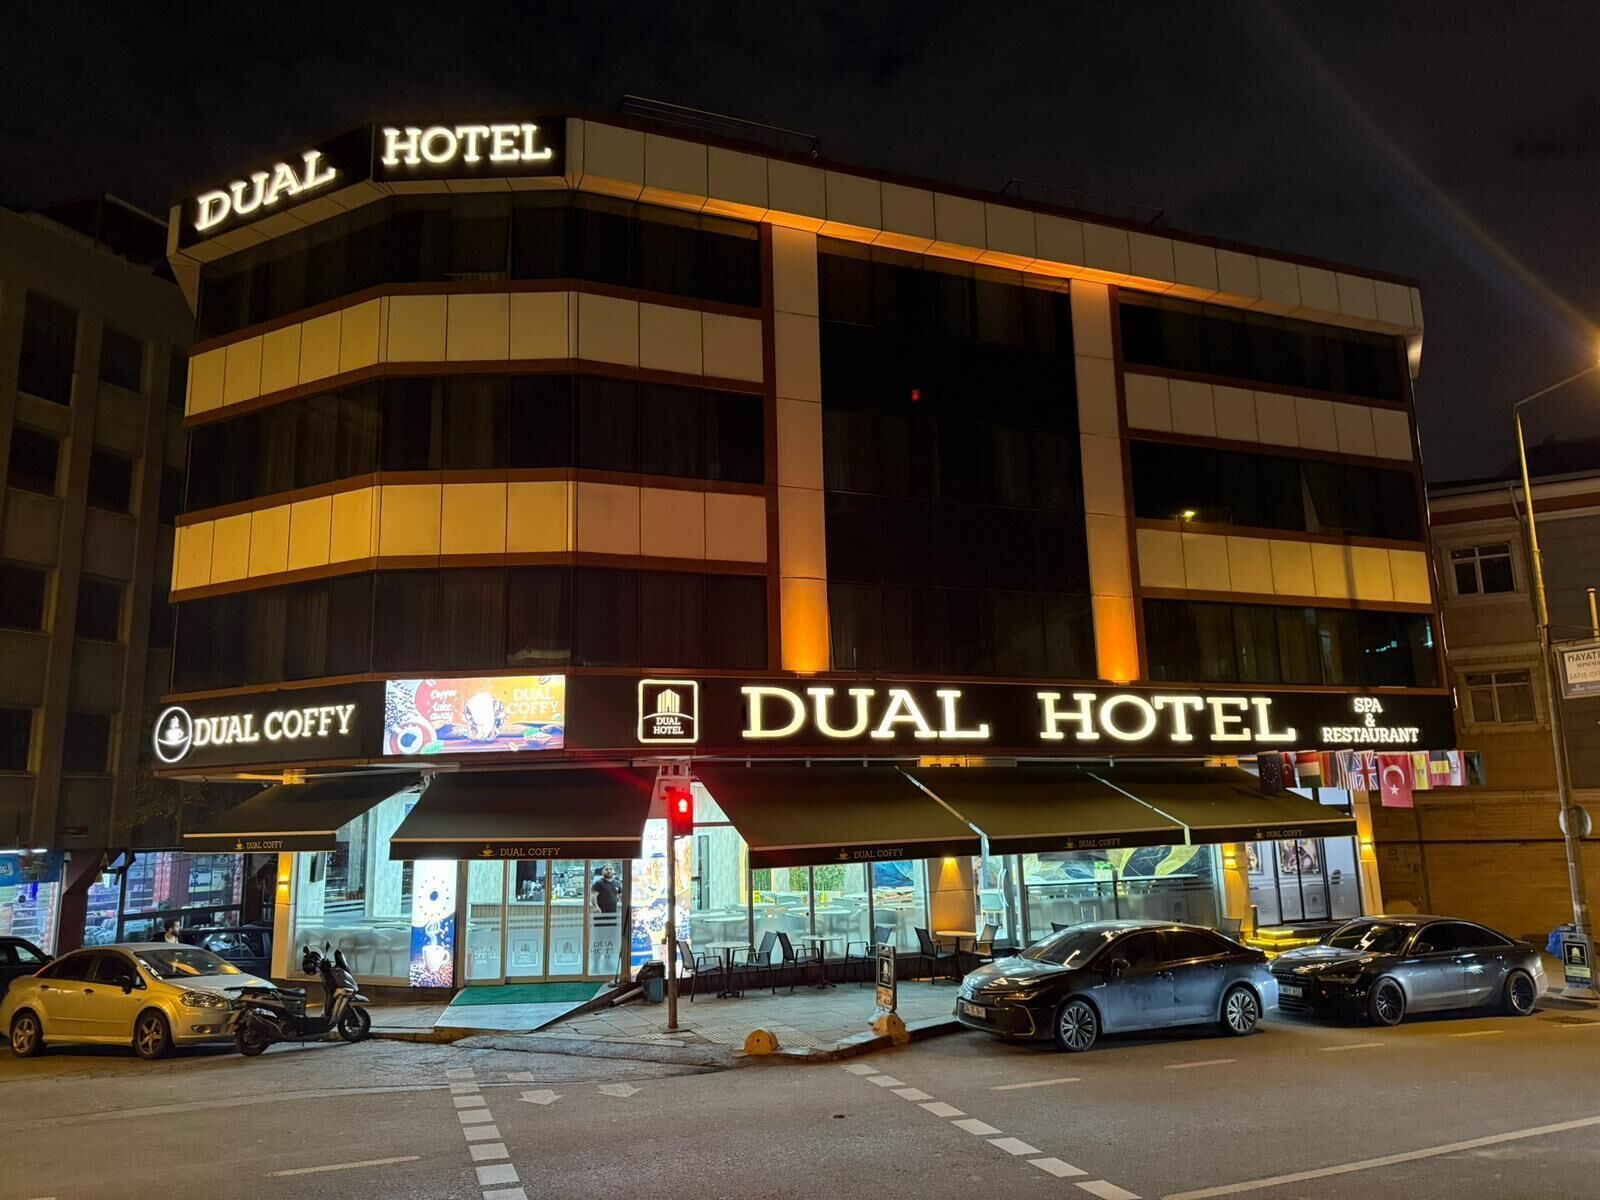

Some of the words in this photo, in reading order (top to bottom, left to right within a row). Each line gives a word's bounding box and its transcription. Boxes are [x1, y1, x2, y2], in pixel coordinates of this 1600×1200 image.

[382, 124, 552, 165] HOTEL
[195, 150, 337, 231] DUAL
[512, 688, 555, 701] DUAL
[507, 701, 560, 714] COFFY
[1353, 697, 1383, 713] SPA
[741, 686, 990, 738] DUAL
[1037, 692, 1297, 741] HOTEL
[1364, 713, 1376, 727] &
[192, 714, 260, 746] DUAL
[263, 704, 355, 740] COFFY
[655, 717, 681, 725] DUAL
[653, 726, 684, 735] HOTEL
[1321, 727, 1419, 743] RESTAURANT
[1266, 829, 1282, 837] DUAL
[246, 841, 262, 849] DUAL
[262, 840, 284, 849] COFFY
[1079, 840, 1097, 848] DUAL
[500, 847, 526, 857] DUAL
[528, 847, 560, 856] COFFY
[853, 850, 876, 859] DUAL
[877, 848, 904, 857] COFFY
